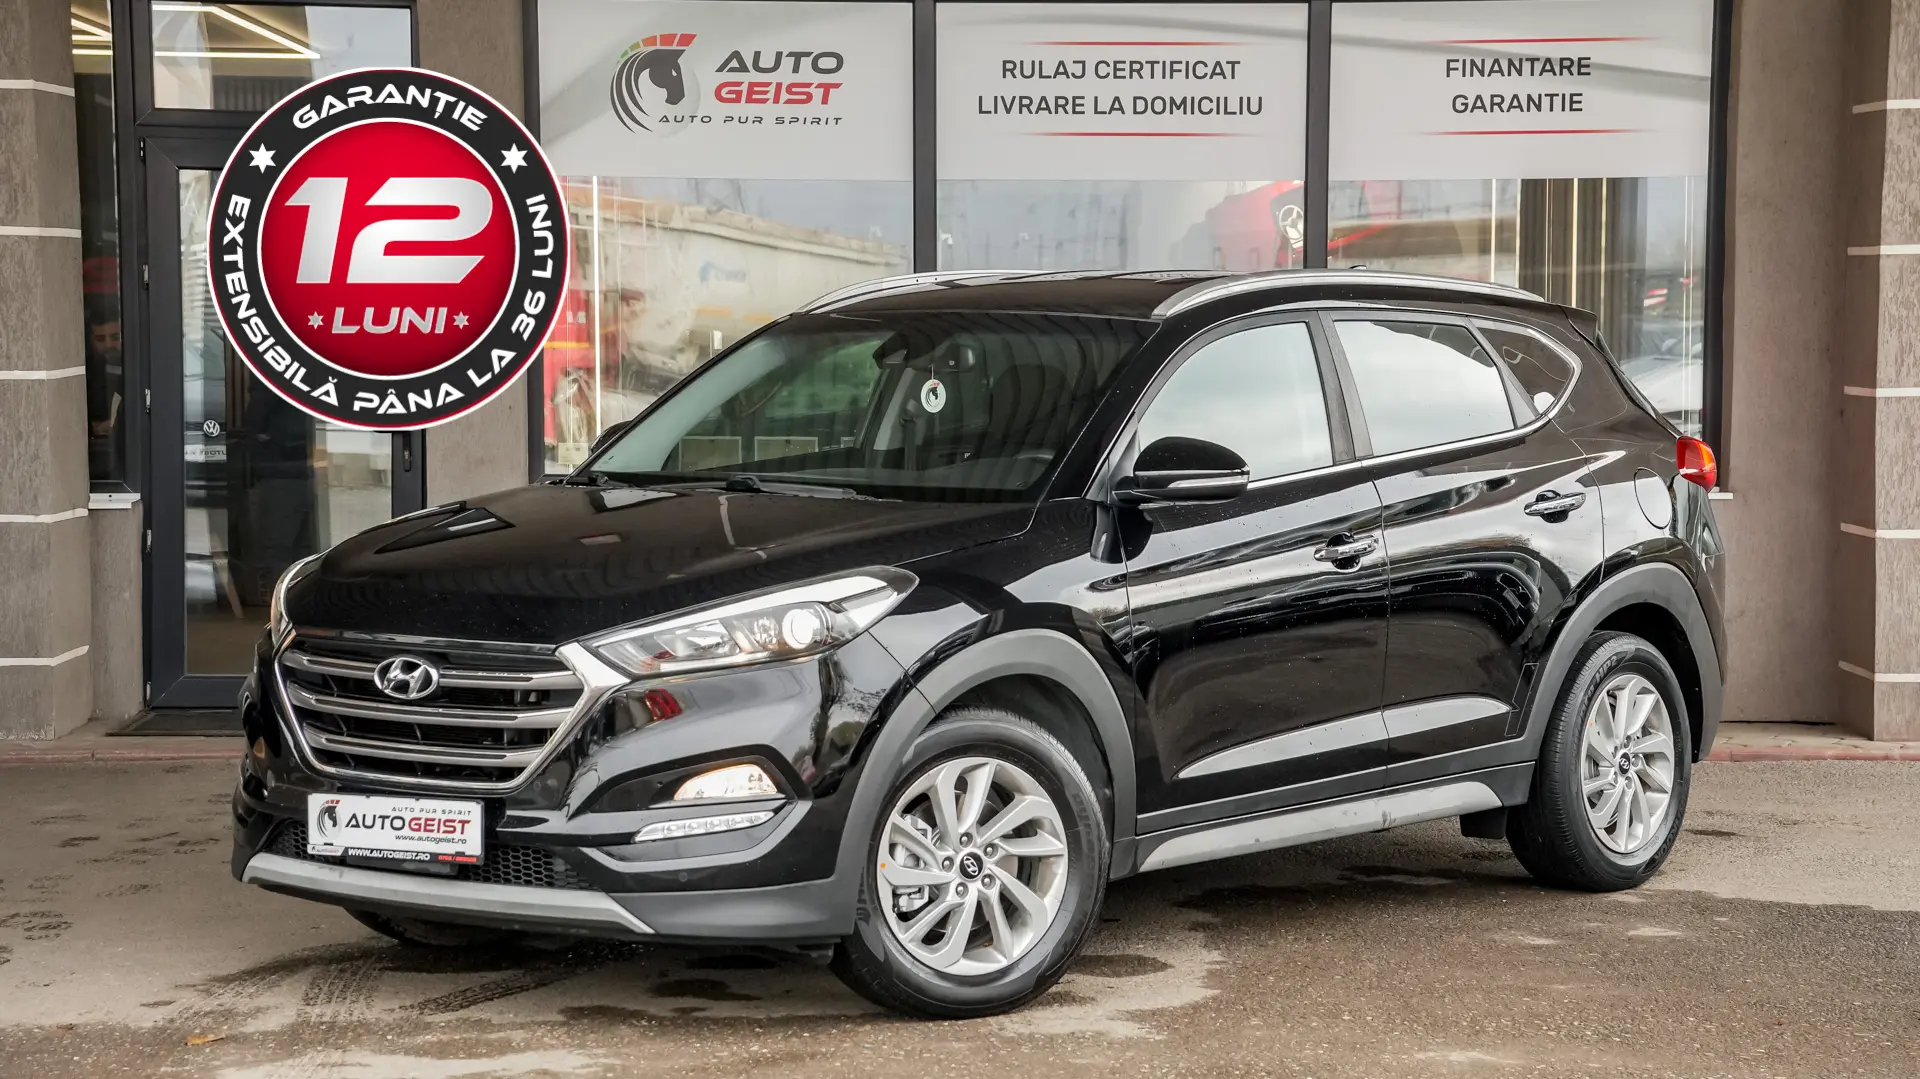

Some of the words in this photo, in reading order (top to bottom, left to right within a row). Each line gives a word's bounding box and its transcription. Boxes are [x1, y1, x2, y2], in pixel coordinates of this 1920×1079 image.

[715, 50, 844, 74] AUTO
[1002, 60, 1086, 79] RULAJ
[1094, 60, 1241, 79] CERTIFICAT
[1446, 57, 1591, 77] FINANTARE
[714, 81, 843, 105] GEIST
[1452, 93, 1583, 113] GARANTIE
[978, 96, 1085, 115] LIVRARE
[1093, 96, 1126, 115] LA
[1132, 96, 1264, 116] DOMICILIU
[658, 115, 712, 124] AUTO
[723, 116, 764, 125] PUR
[774, 117, 842, 126] SPIRIT
[419, 807, 437, 815] PUR
[345, 812, 471, 835] AUTOGEIST
[395, 834, 467, 845] www.autogeist.ro
[348, 848, 431, 861] WWW.AUTOGEIST.RO
